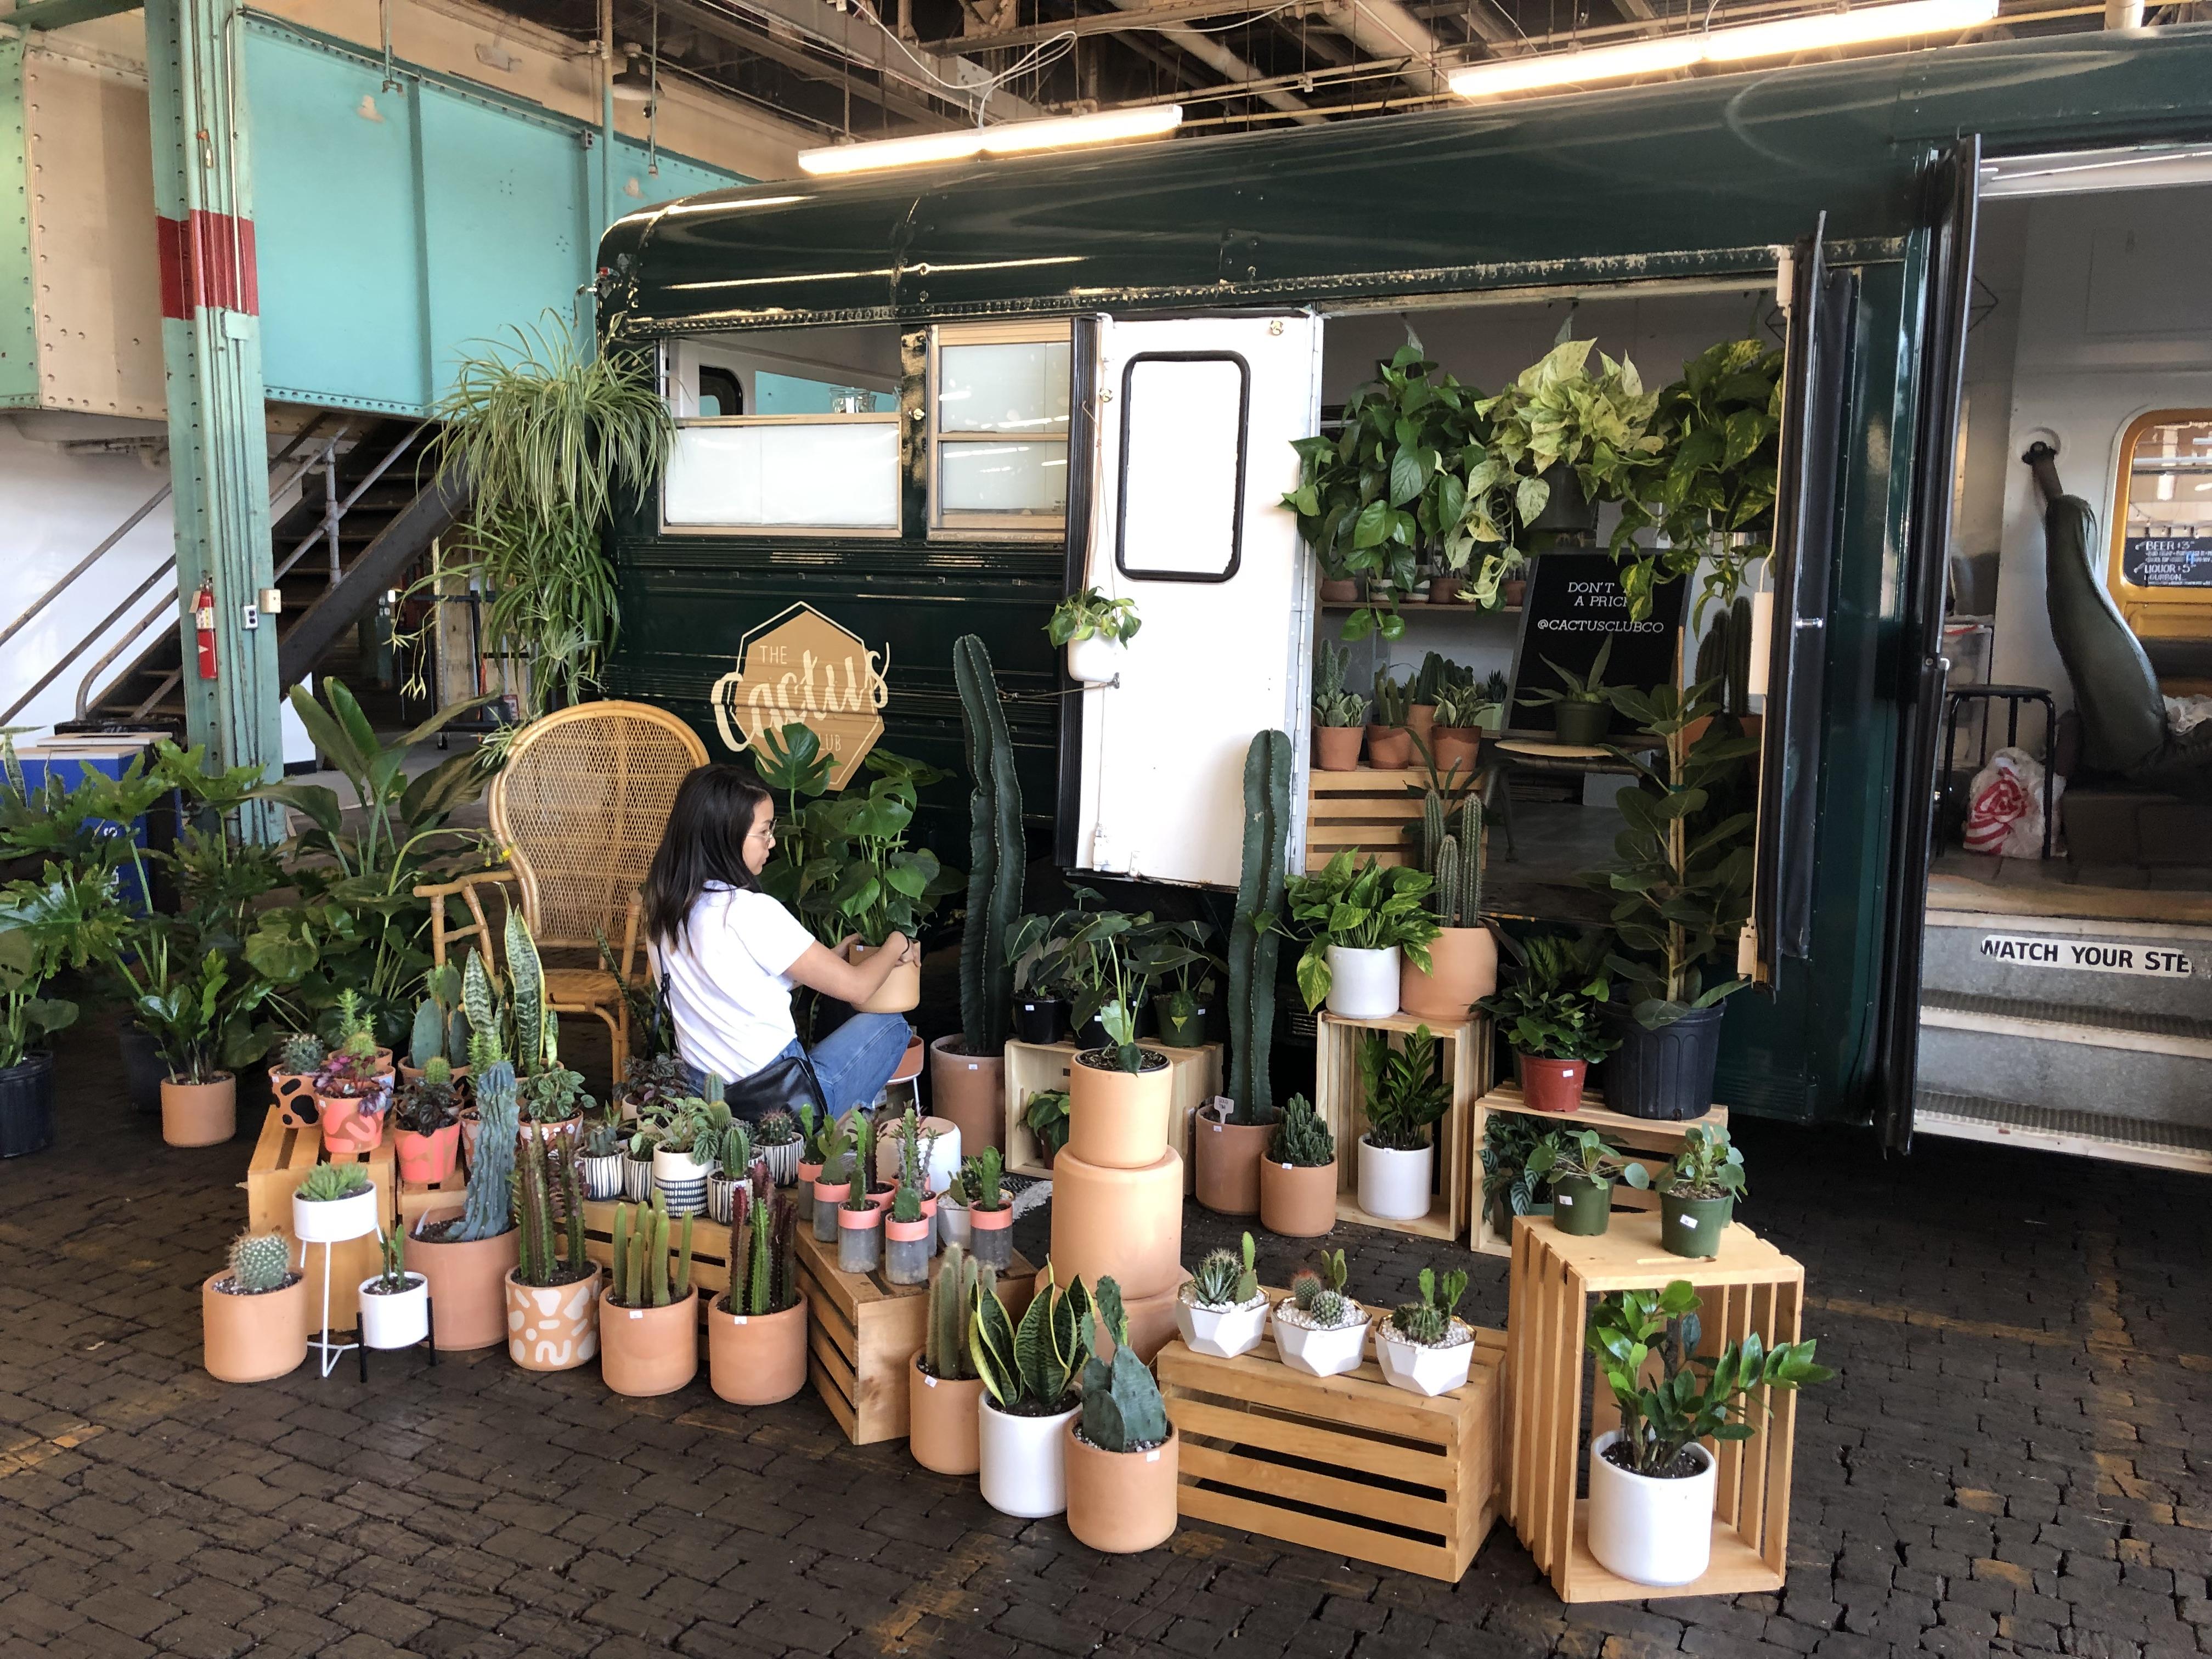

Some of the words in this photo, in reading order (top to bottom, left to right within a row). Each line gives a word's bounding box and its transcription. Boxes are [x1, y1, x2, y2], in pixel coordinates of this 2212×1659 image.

[2146, 540, 2175, 551] BEER
[1567, 582, 1615, 593] DON'T
[1574, 595, 1584, 606] A
[1538, 619, 1664, 633] @CACTUSCLUBCO
[759, 645, 788, 664] THE
[710, 642, 890, 752] Cactus
[818, 733, 841, 752] LUB
[1980, 940, 2058, 962] WATCH
[2071, 946, 2133, 968] YOUR
[2145, 951, 2192, 973] STE
